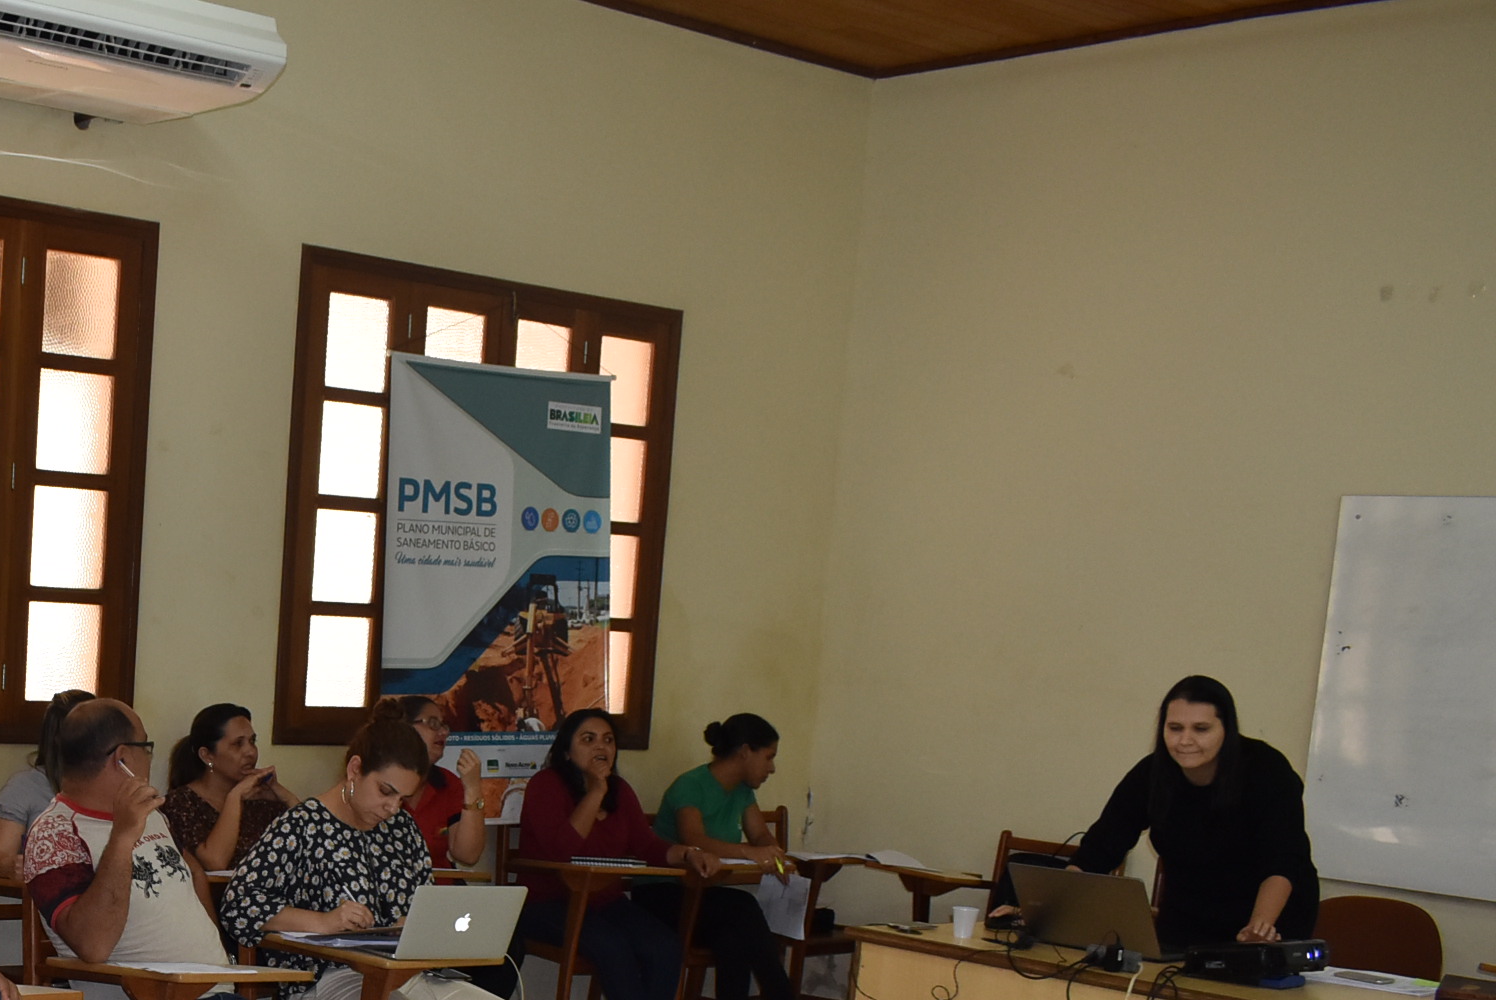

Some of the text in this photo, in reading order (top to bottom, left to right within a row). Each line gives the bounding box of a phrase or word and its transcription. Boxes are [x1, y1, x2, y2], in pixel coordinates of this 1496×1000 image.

[397, 477, 497, 517] PMSB
[397, 522, 497, 538] PLANO MUNICIPAL DE
[396, 536, 496, 552] SANEAMENTO BÁSICO
[394, 551, 497, 568] Uma cidade mais saudável
[491, 733, 515, 741] SÓLIDOS
